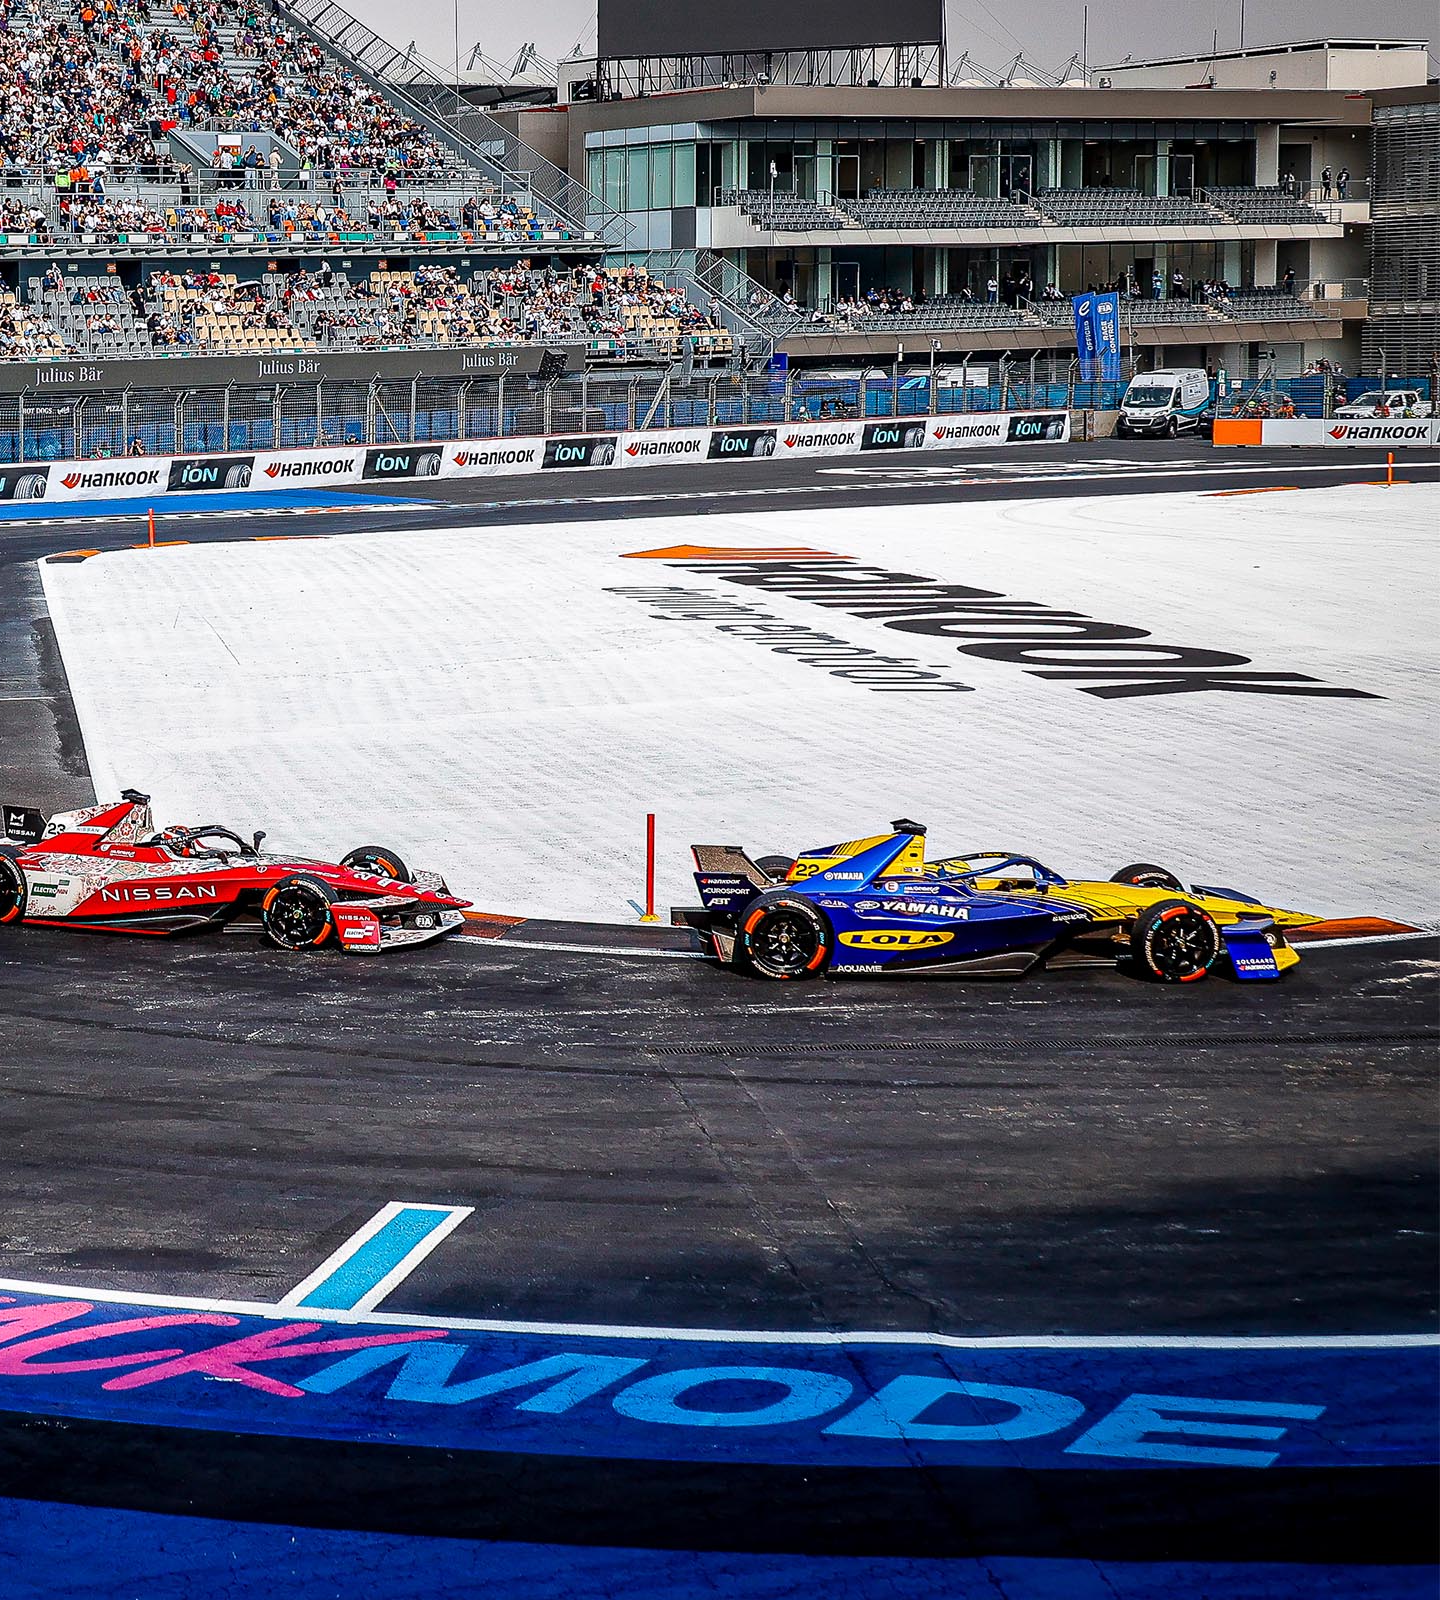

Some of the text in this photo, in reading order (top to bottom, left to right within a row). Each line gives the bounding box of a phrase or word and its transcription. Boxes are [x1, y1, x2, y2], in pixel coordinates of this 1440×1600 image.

[1109, 319, 1117, 354] CONTROL
[258, 357, 321, 377] Julius Bär
[461, 349, 519, 372] Julius Bär
[36, 365, 104, 386] Julius Bär
[36, 407, 52, 415] DOGS
[8, 828, 36, 837] NISSAN
[47, 822, 66, 835] 23
[160, 836, 189, 845] NISSAN
[795, 863, 820, 877] 22
[833, 872, 864, 881] YAMAHA
[101, 885, 217, 902] NISSAN
[881, 901, 971, 921] YAMAHA
[417, 916, 432, 927] FIA
[850, 934, 945, 945] LOLA
[836, 965, 883, 973] AQUAME
[296, 1341, 1326, 1470] MODE
